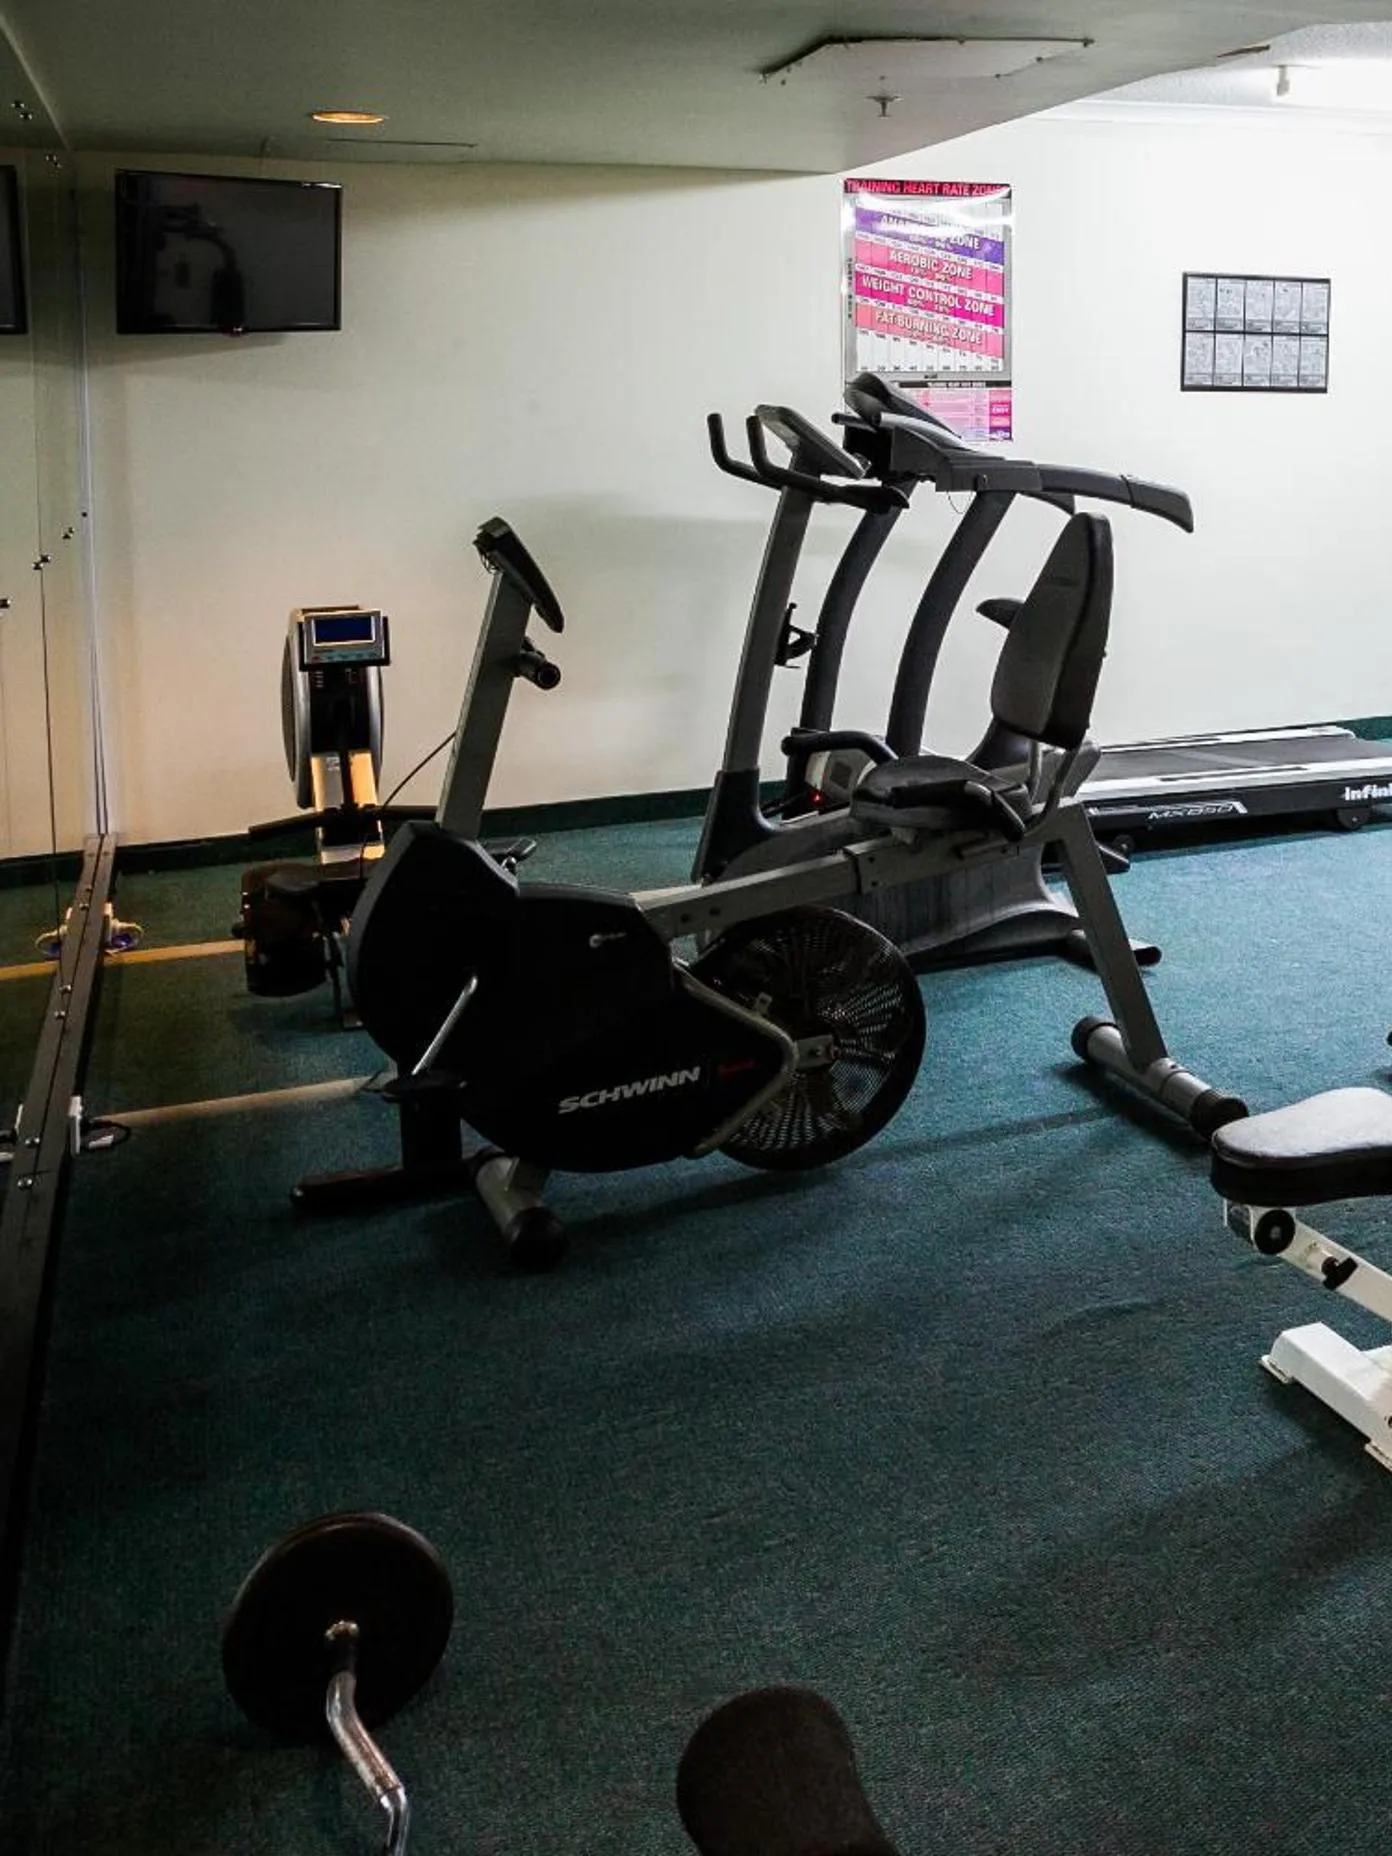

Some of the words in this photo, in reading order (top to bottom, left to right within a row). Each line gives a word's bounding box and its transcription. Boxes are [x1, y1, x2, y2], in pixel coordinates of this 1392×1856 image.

[846, 180, 901, 195] TRAINING
[903, 181, 939, 195] HEART
[942, 183, 969, 196] RATE
[889, 250, 940, 271] AEROBIC
[941, 262, 973, 279] ZONE
[862, 275, 905, 292] WEIGHT
[908, 286, 961, 308] CONTROL
[964, 301, 995, 316] ZONE
[876, 311, 895, 323] FAT
[895, 316, 949, 336] BURNING
[952, 329, 982, 345] ZONE
[558, 1066, 701, 1114] SCHWINN
